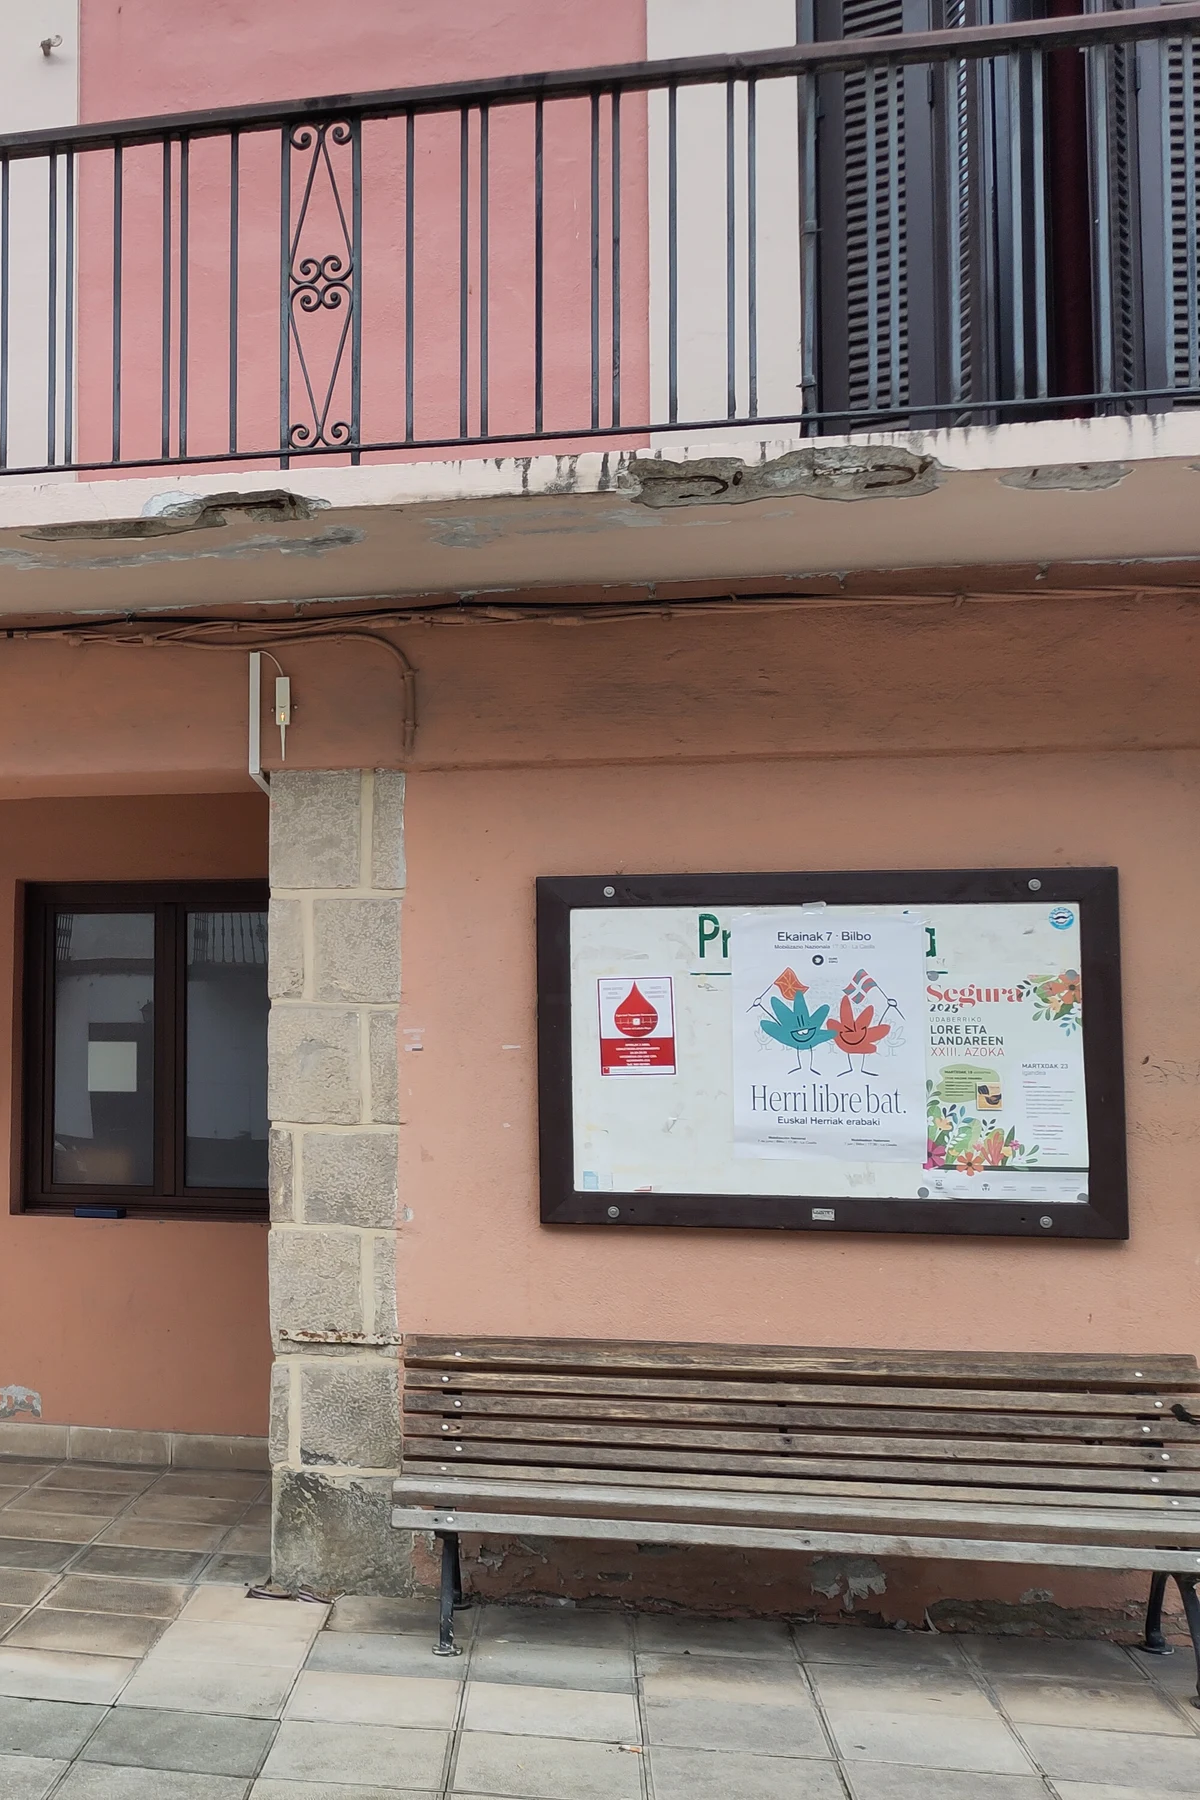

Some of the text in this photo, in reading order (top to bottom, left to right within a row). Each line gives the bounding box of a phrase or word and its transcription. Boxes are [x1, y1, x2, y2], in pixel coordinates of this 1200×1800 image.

[777, 931, 872, 942] Ekainak 7 Bilbo
[926, 984, 1024, 1008] Segura
[929, 1003, 959, 1013] 2025
[930, 1025, 987, 1035] LORE ETA
[930, 1036, 1004, 1046] LANDAREEN
[930, 1047, 1005, 1057] XXIII. AZOKA
[751, 1083, 907, 1114] Herri libre bat.
[777, 1116, 881, 1126] Euskal Herriak erabaki
